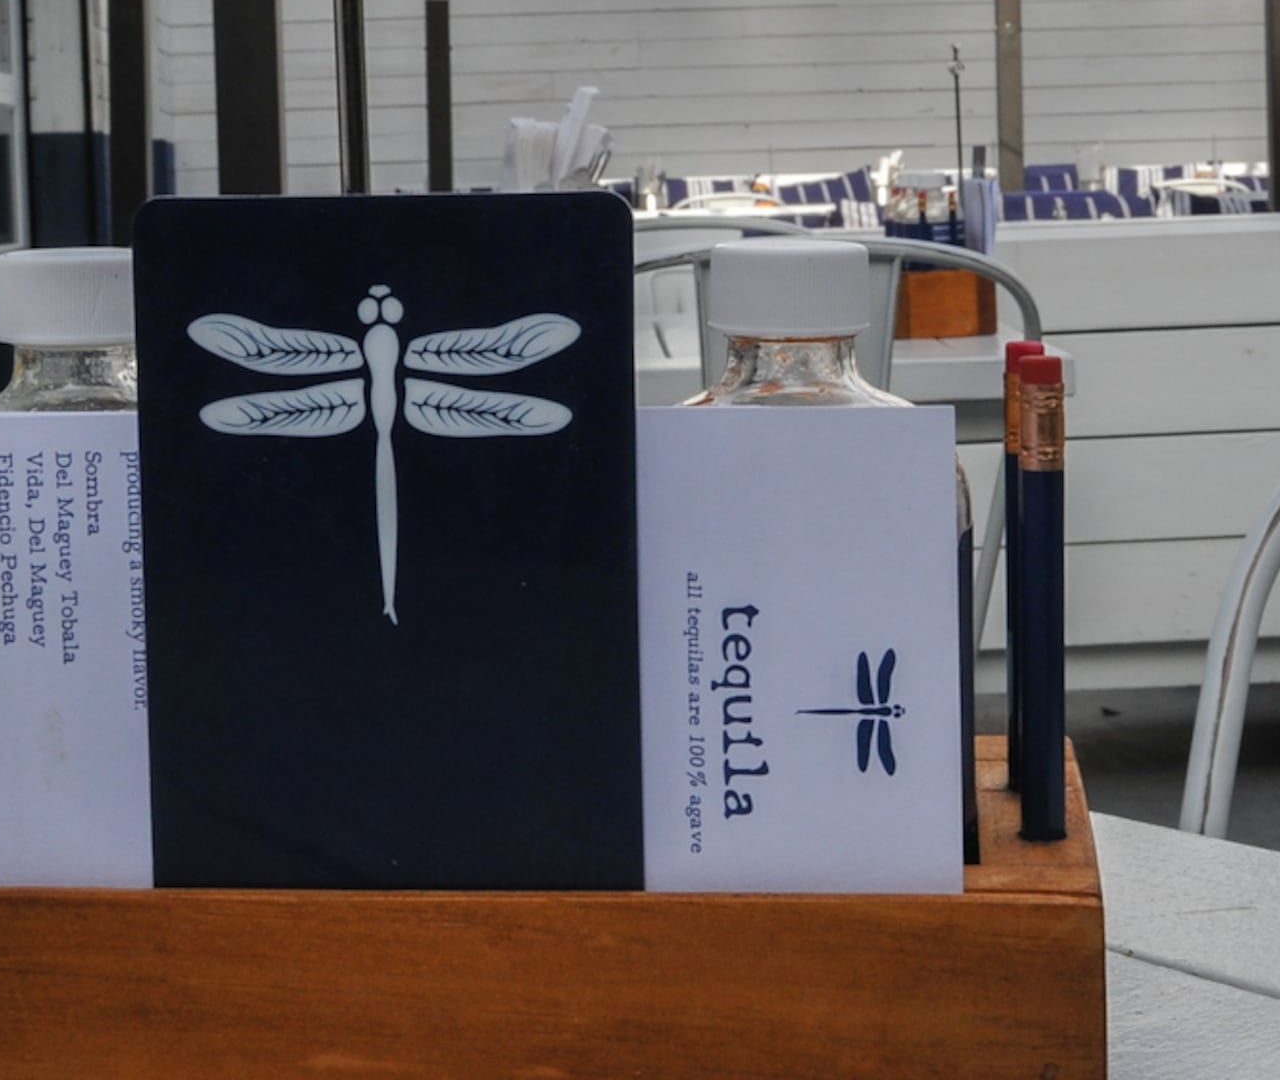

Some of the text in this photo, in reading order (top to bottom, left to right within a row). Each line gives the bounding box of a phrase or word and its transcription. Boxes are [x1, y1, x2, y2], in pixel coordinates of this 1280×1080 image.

[25, 452, 47, 647] Vida, Del Maguey
[53, 452, 79, 664] Del Maguey Tobala
[85, 451, 103, 536] Sombra
[120, 450, 140, 554] producing
[125, 576, 146, 642] smoky
[683, 572, 707, 853] all tequilas are 100% agave
[711, 605, 769, 819] tequila
